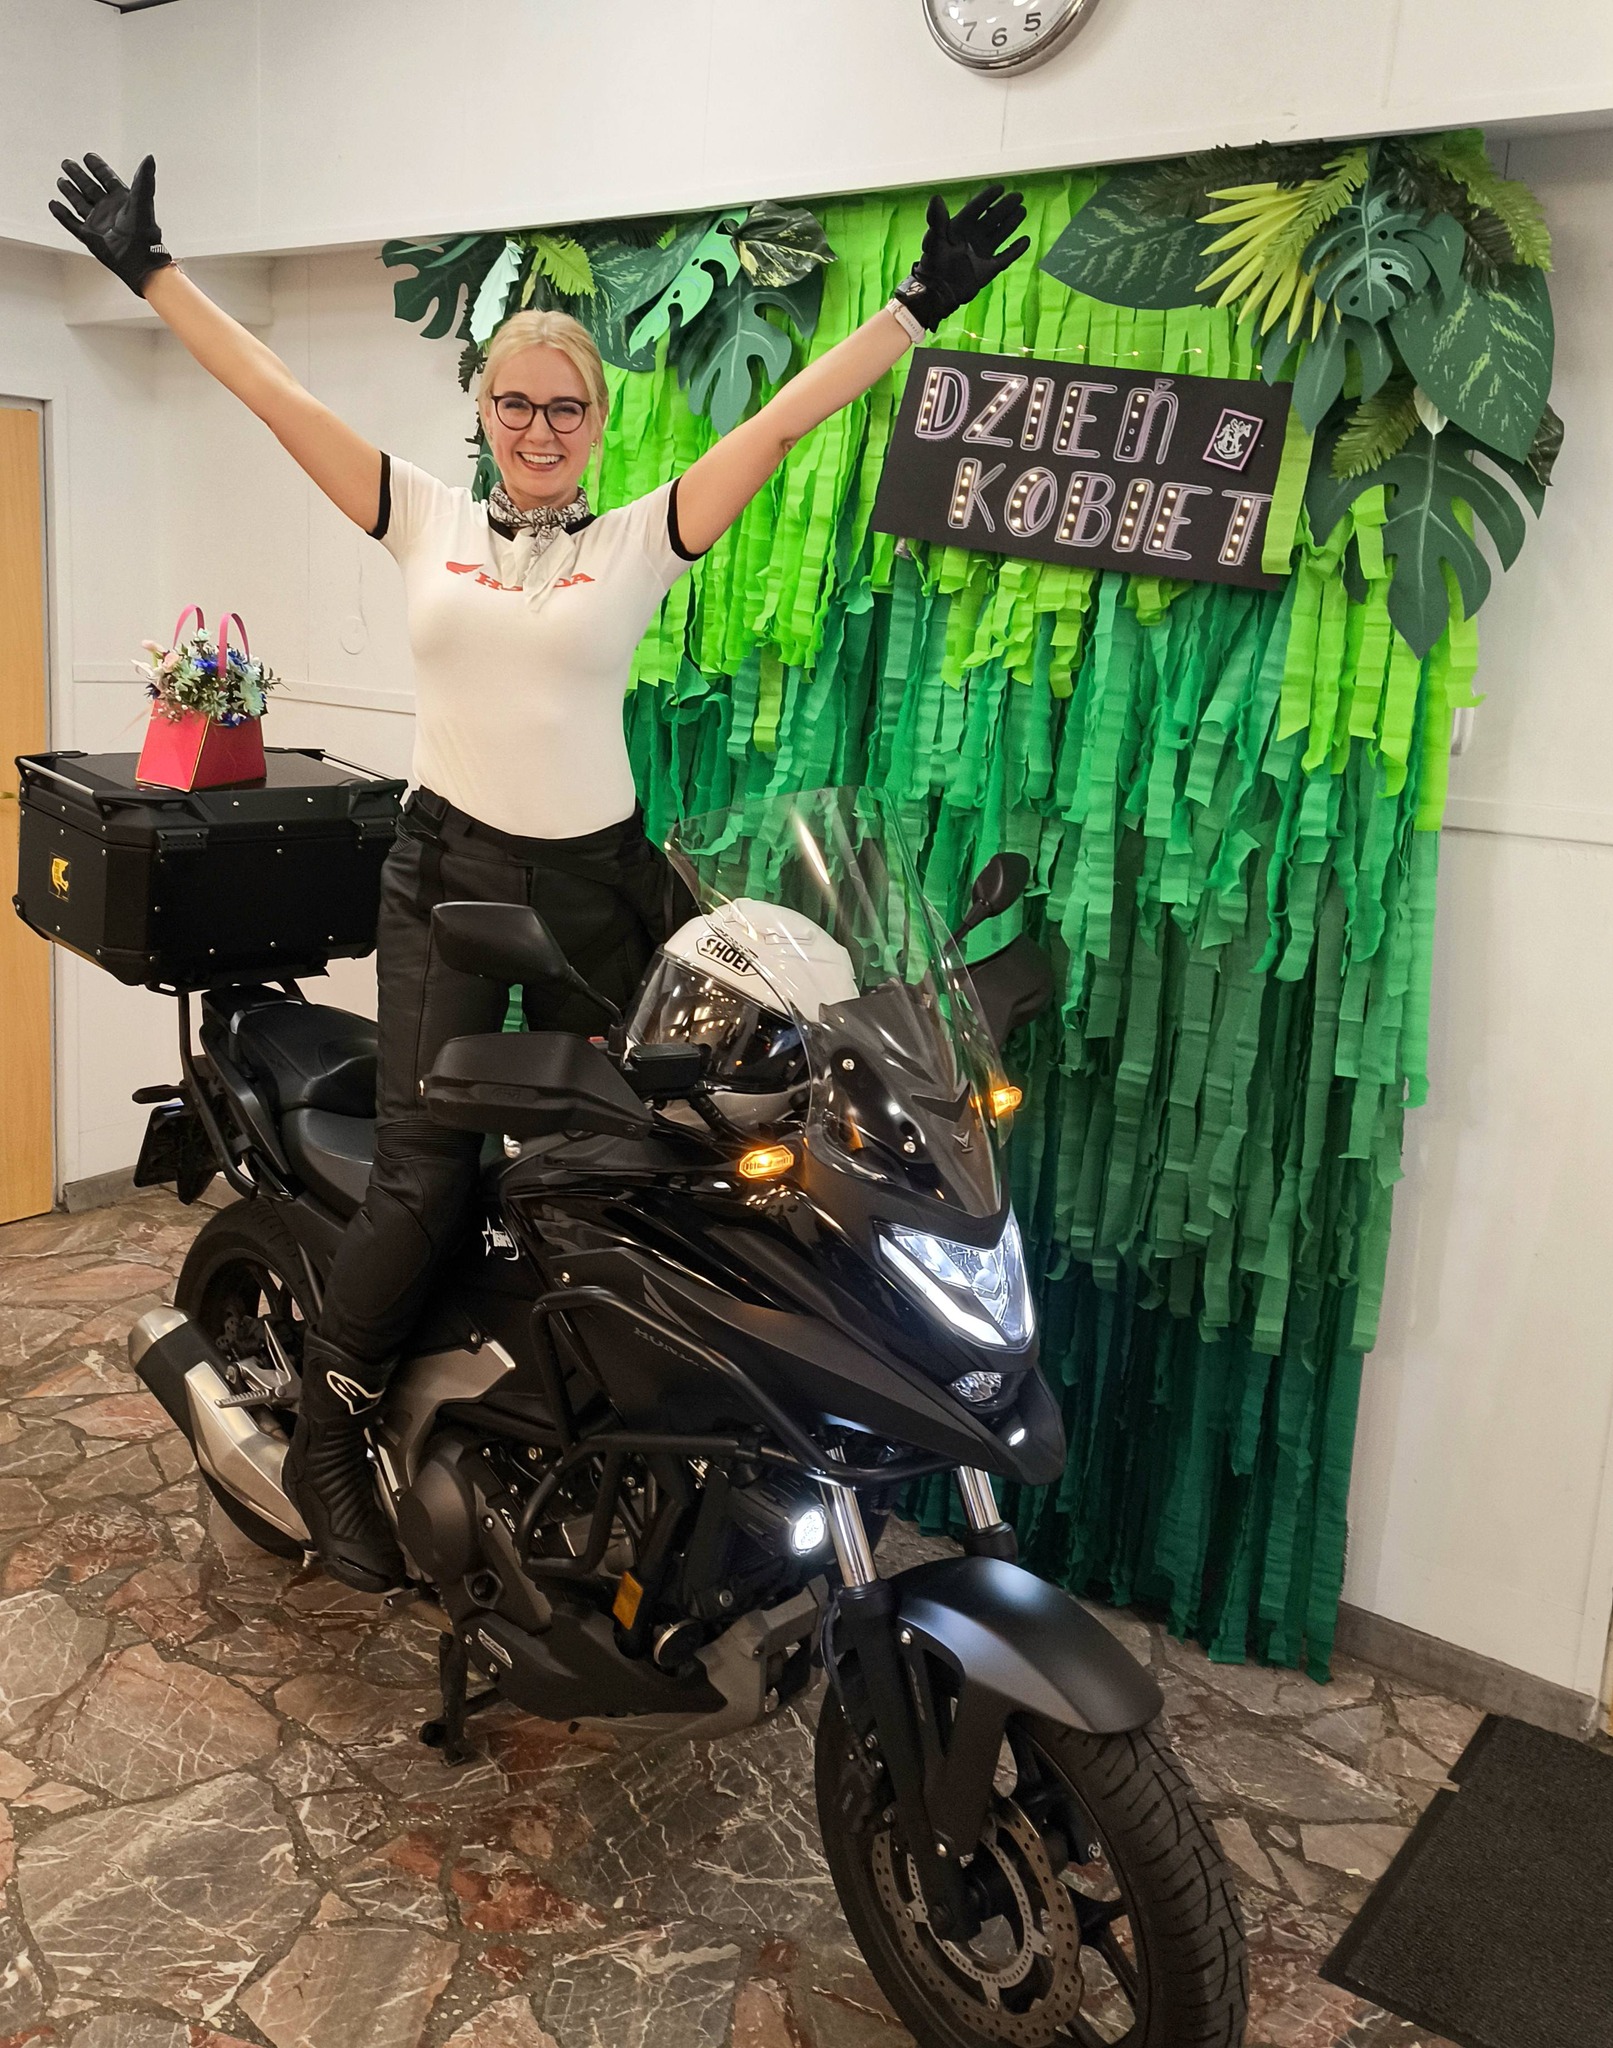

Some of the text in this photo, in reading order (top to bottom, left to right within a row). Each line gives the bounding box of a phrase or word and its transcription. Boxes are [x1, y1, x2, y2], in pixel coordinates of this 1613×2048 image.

[963, 21, 978, 42] 7
[1023, 12, 1042, 32] 5
[991, 27, 1008, 47] 6
[947, 457, 1274, 567] KOBIET
